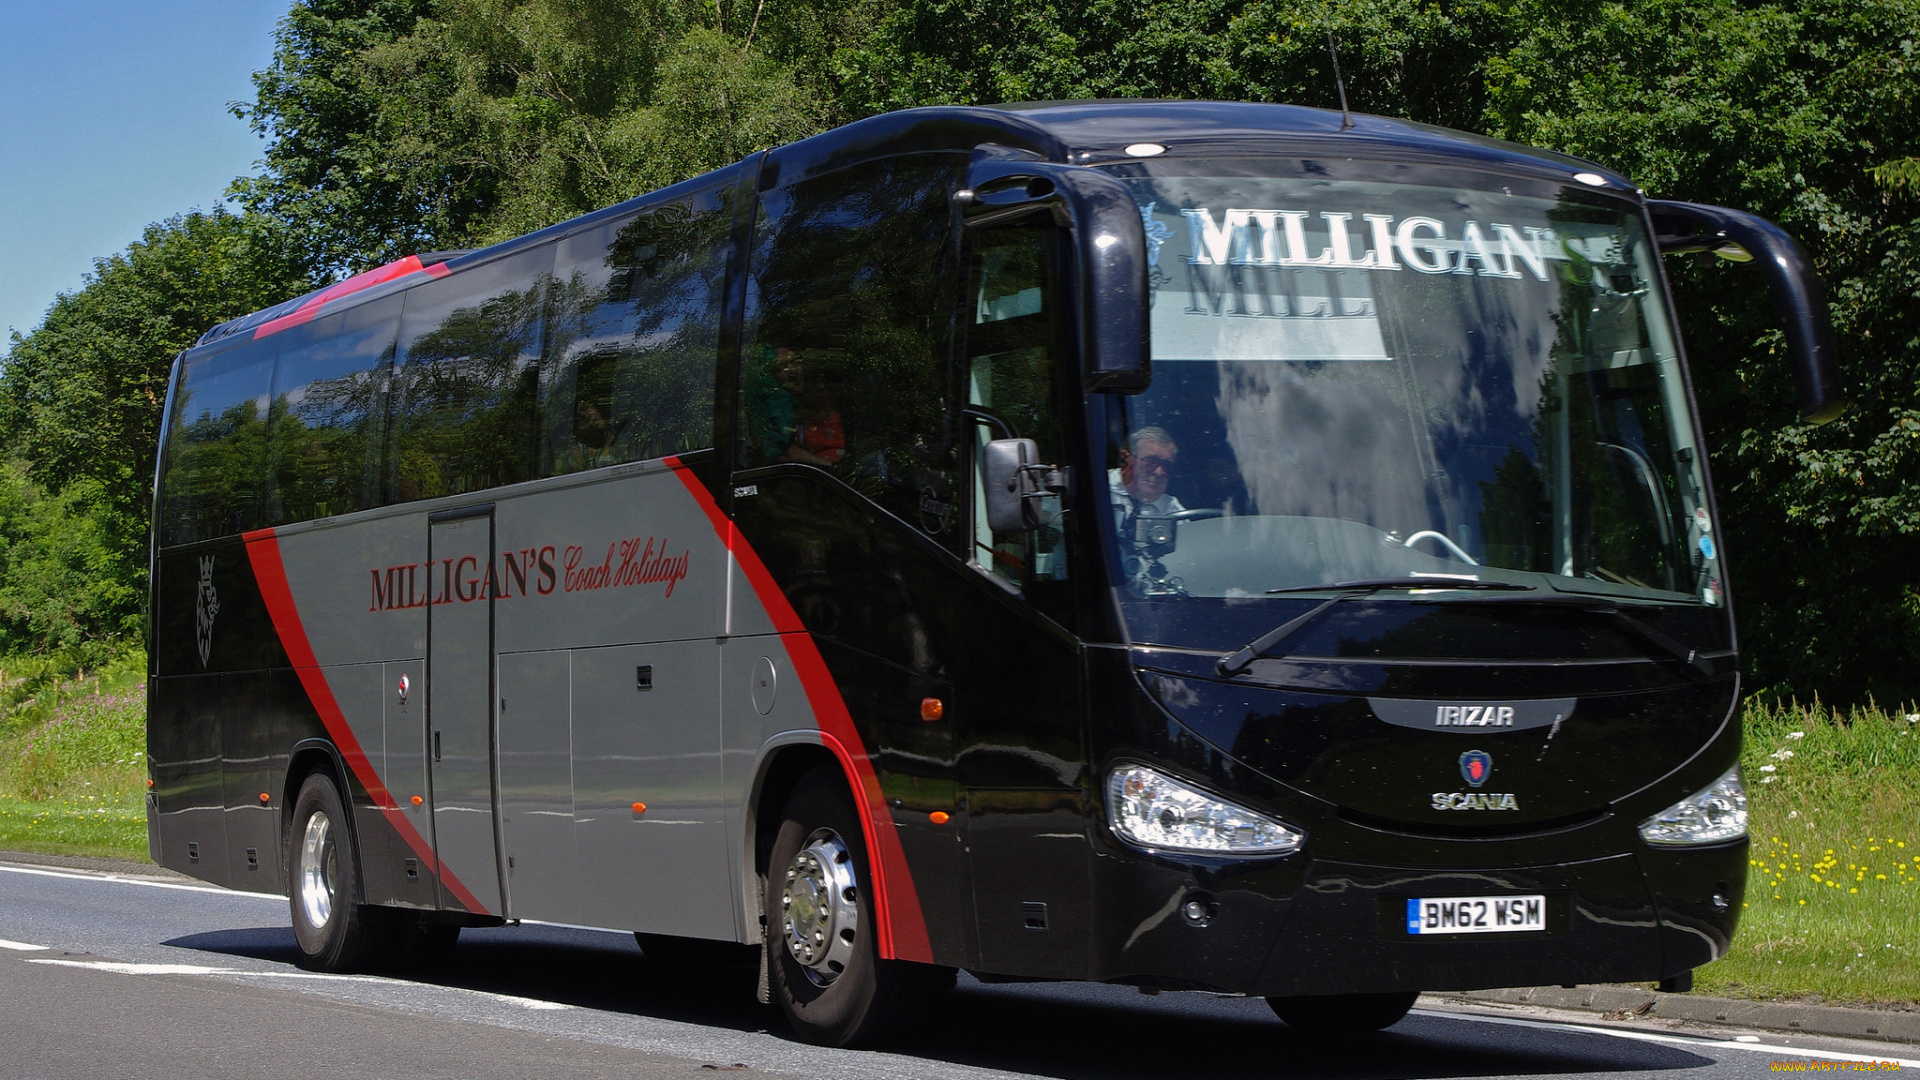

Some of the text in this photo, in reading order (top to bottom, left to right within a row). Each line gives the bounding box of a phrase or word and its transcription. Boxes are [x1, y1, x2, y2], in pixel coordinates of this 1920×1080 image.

[369, 536, 690, 612] MILLIGAN'S Coach Holidays
[1435, 705, 1514, 727] IRIZAR
[1431, 792, 1520, 811] SCANIA
[1424, 899, 1541, 929] BM62 WSM
